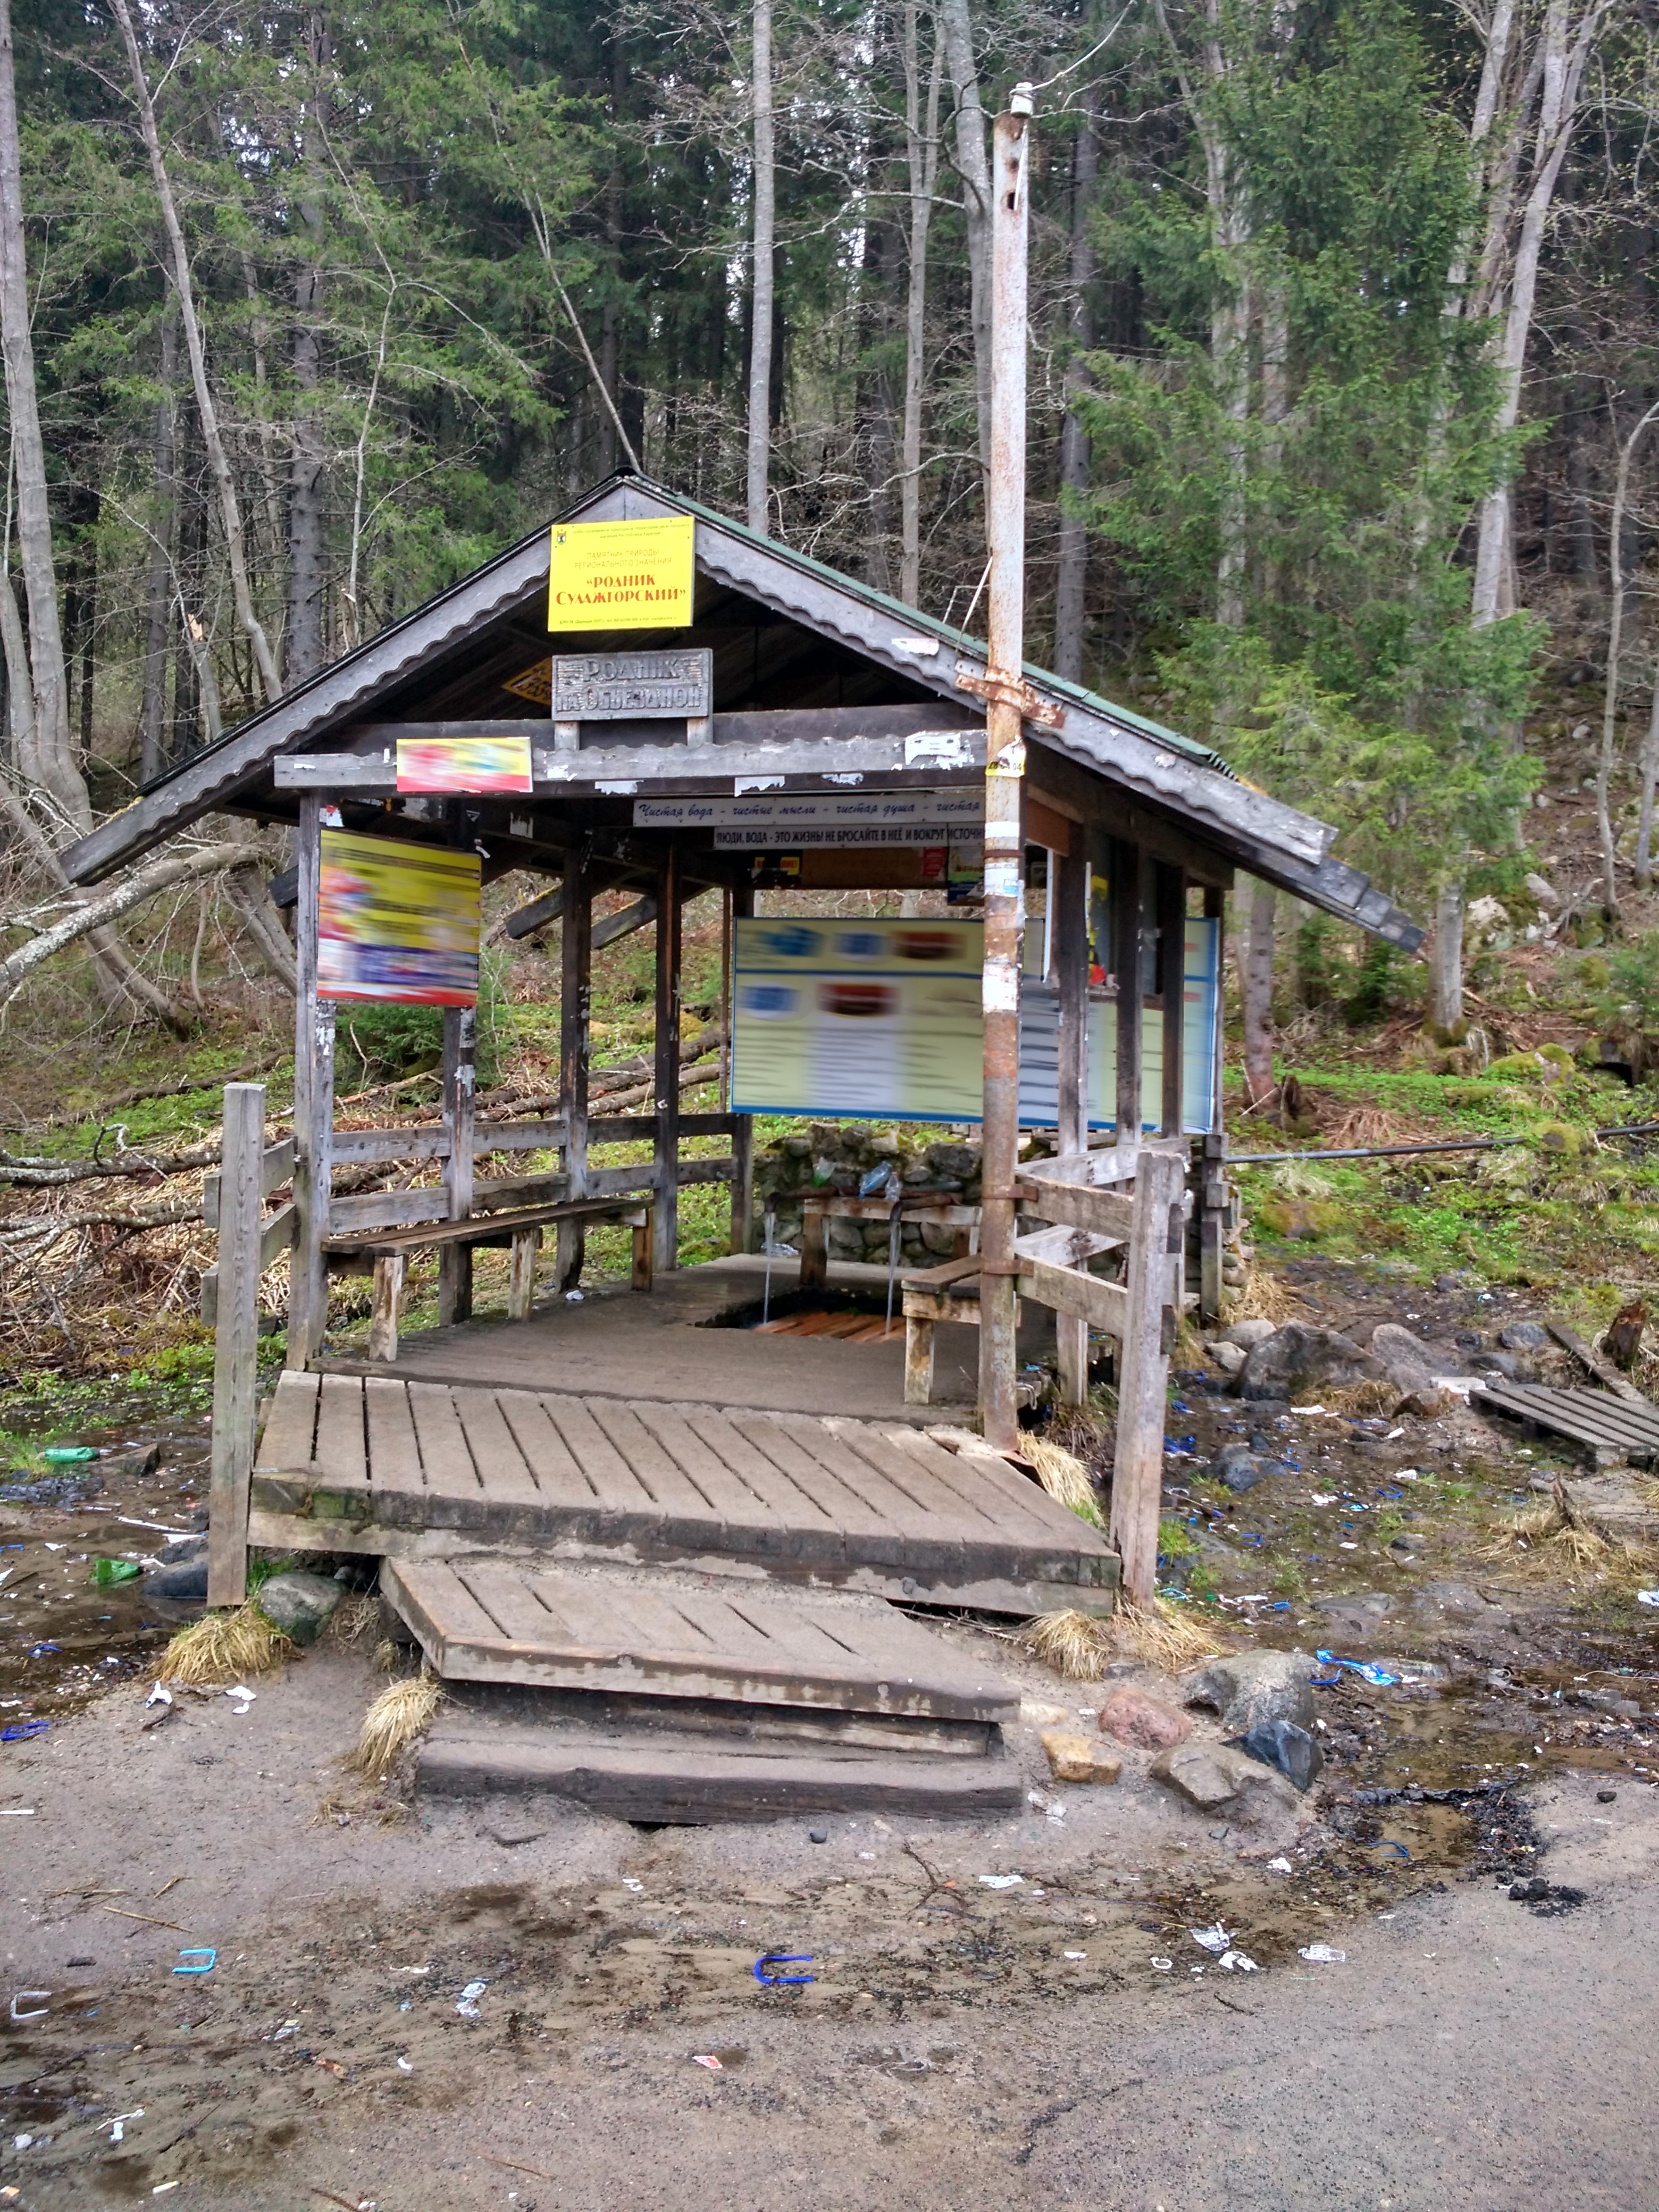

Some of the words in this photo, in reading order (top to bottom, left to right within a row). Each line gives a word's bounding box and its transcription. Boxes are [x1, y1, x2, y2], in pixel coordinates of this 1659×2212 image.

[575, 559, 633, 569] РЕГИОНАЛЬНОГО
[635, 557, 672, 566] ЗНАЧЕНИЯ
[587, 550, 623, 559] ПАМЯТНИК
[625, 549, 659, 558] ПРИРОДЫ
[583, 658, 680, 682] РОДНИК
[639, 804, 683, 817] Чистая
[688, 804, 713, 820] вода
[732, 804, 772, 815] чистые
[779, 806, 816, 815] мысли
[836, 802, 877, 814] чистая
[883, 803, 915, 817] душа
[936, 800, 979, 812] чистая
[717, 832, 743, 845] ЛЮДИ,
[745, 832, 767, 844] ВОДА
[775, 831, 791, 842] ЭТО
[792, 831, 824, 842] ЖИЗНЬ!
[825, 831, 835, 842] НЕ
[837, 827, 879, 842] БРОСАЙТЕ
[881, 830, 886, 841] В
[905, 829, 911, 840] И
[914, 829, 945, 840] ВОКРУГ
[948, 828, 983, 840] ИСТОЧН
